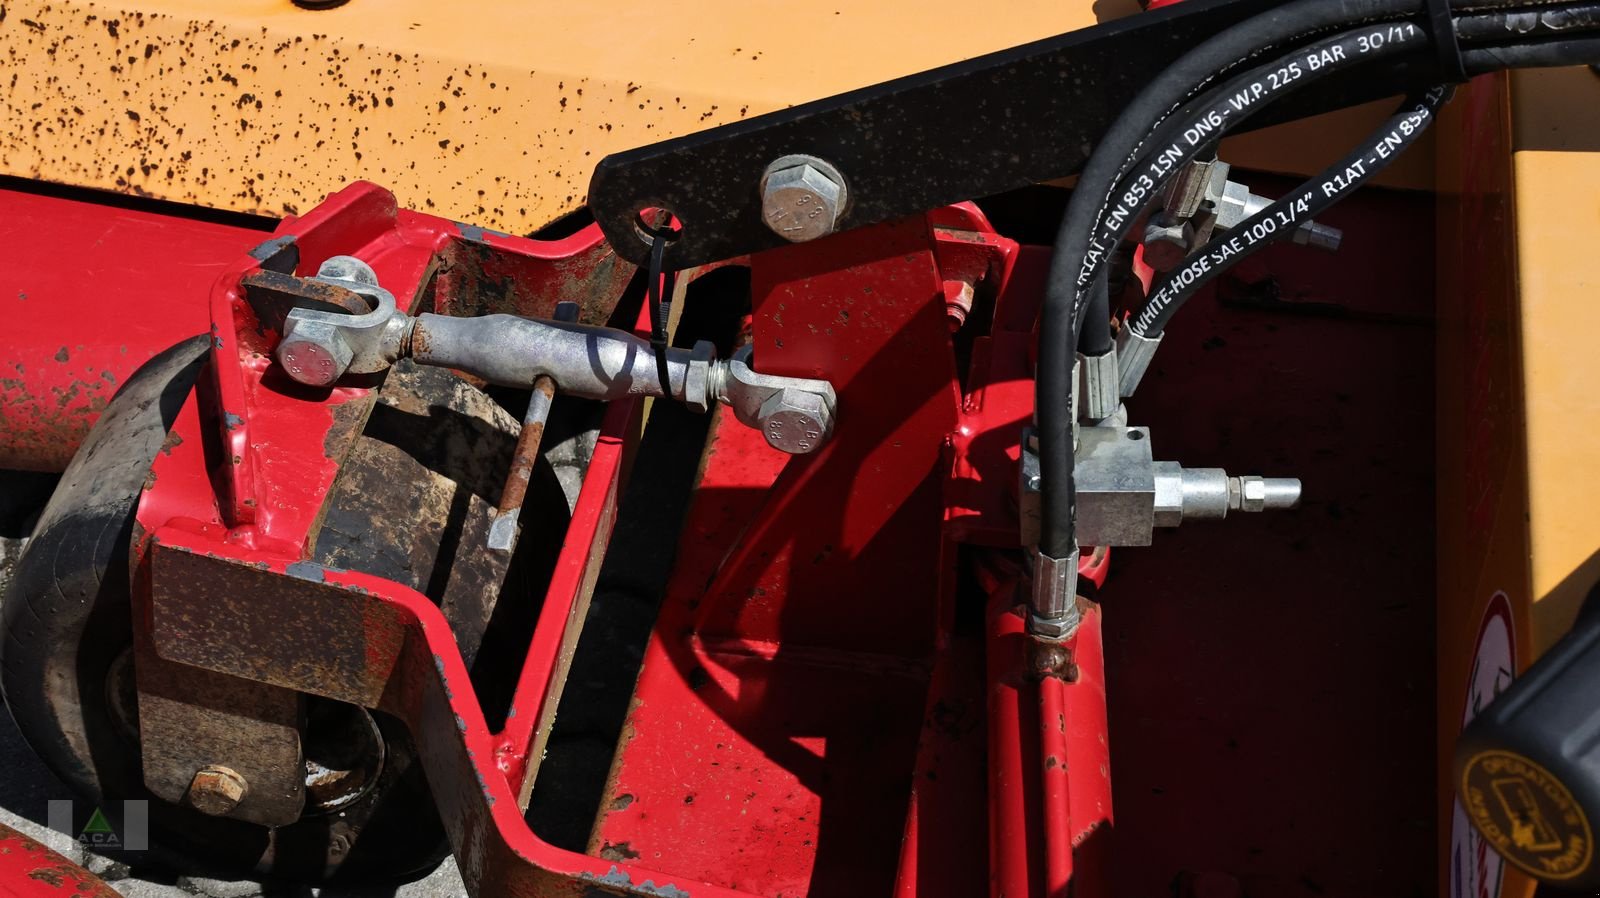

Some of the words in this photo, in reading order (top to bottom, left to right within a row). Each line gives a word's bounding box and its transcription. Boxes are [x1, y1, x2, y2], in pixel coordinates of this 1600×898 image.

[1105, 203, 1129, 231] EN
[1123, 173, 1154, 208] 853
[1150, 143, 1184, 178] 1SN
[1183, 110, 1222, 146] DN6
[1228, 82, 1269, 111] W.P.
[1266, 61, 1302, 90] 225
[1306, 44, 1346, 72] BAR
[1132, 254, 1211, 338] WHITE-HOSE
[1211, 237, 1244, 265] SAE
[1242, 217, 1276, 246] 100
[1321, 158, 1366, 198] R1AT
[1375, 131, 1403, 159] EN
[1399, 103, 1430, 136] 853
